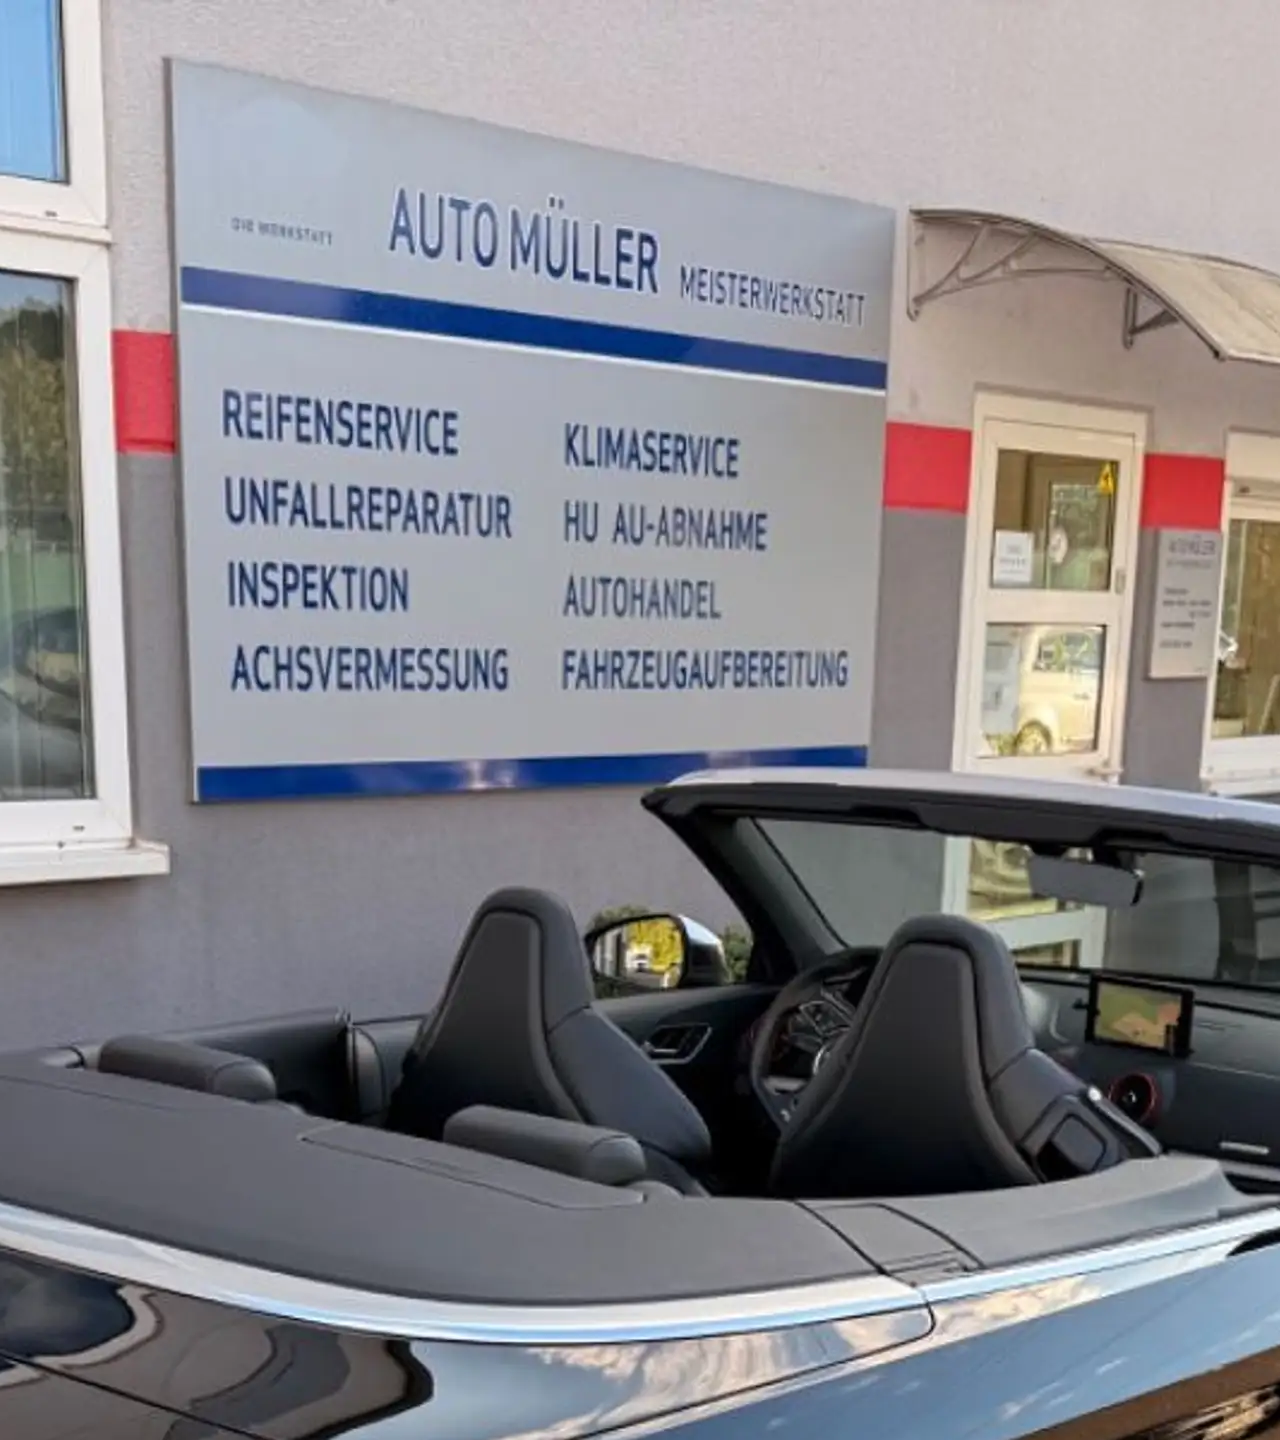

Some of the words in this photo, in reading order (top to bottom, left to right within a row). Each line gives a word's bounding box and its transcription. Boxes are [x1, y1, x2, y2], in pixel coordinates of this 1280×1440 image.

[390, 187, 498, 267] AUTO
[510, 196, 659, 294] MÜLLER
[680, 264, 866, 326] MEISTERWERKSTATT
[222, 388, 459, 456] REIFENSERVICE
[564, 422, 739, 479] KLIMASERVICE
[224, 476, 512, 539] UNFALLREPARATUR
[564, 500, 598, 543] HU
[612, 502, 767, 551] AU-ABNAHME
[228, 560, 409, 612] INSPEKTION
[563, 575, 723, 620] AUTOHANDEL
[231, 644, 510, 692] ACHSVERMESSUNG
[562, 648, 850, 690] FAHRZEUGAUFBEREITUNG
